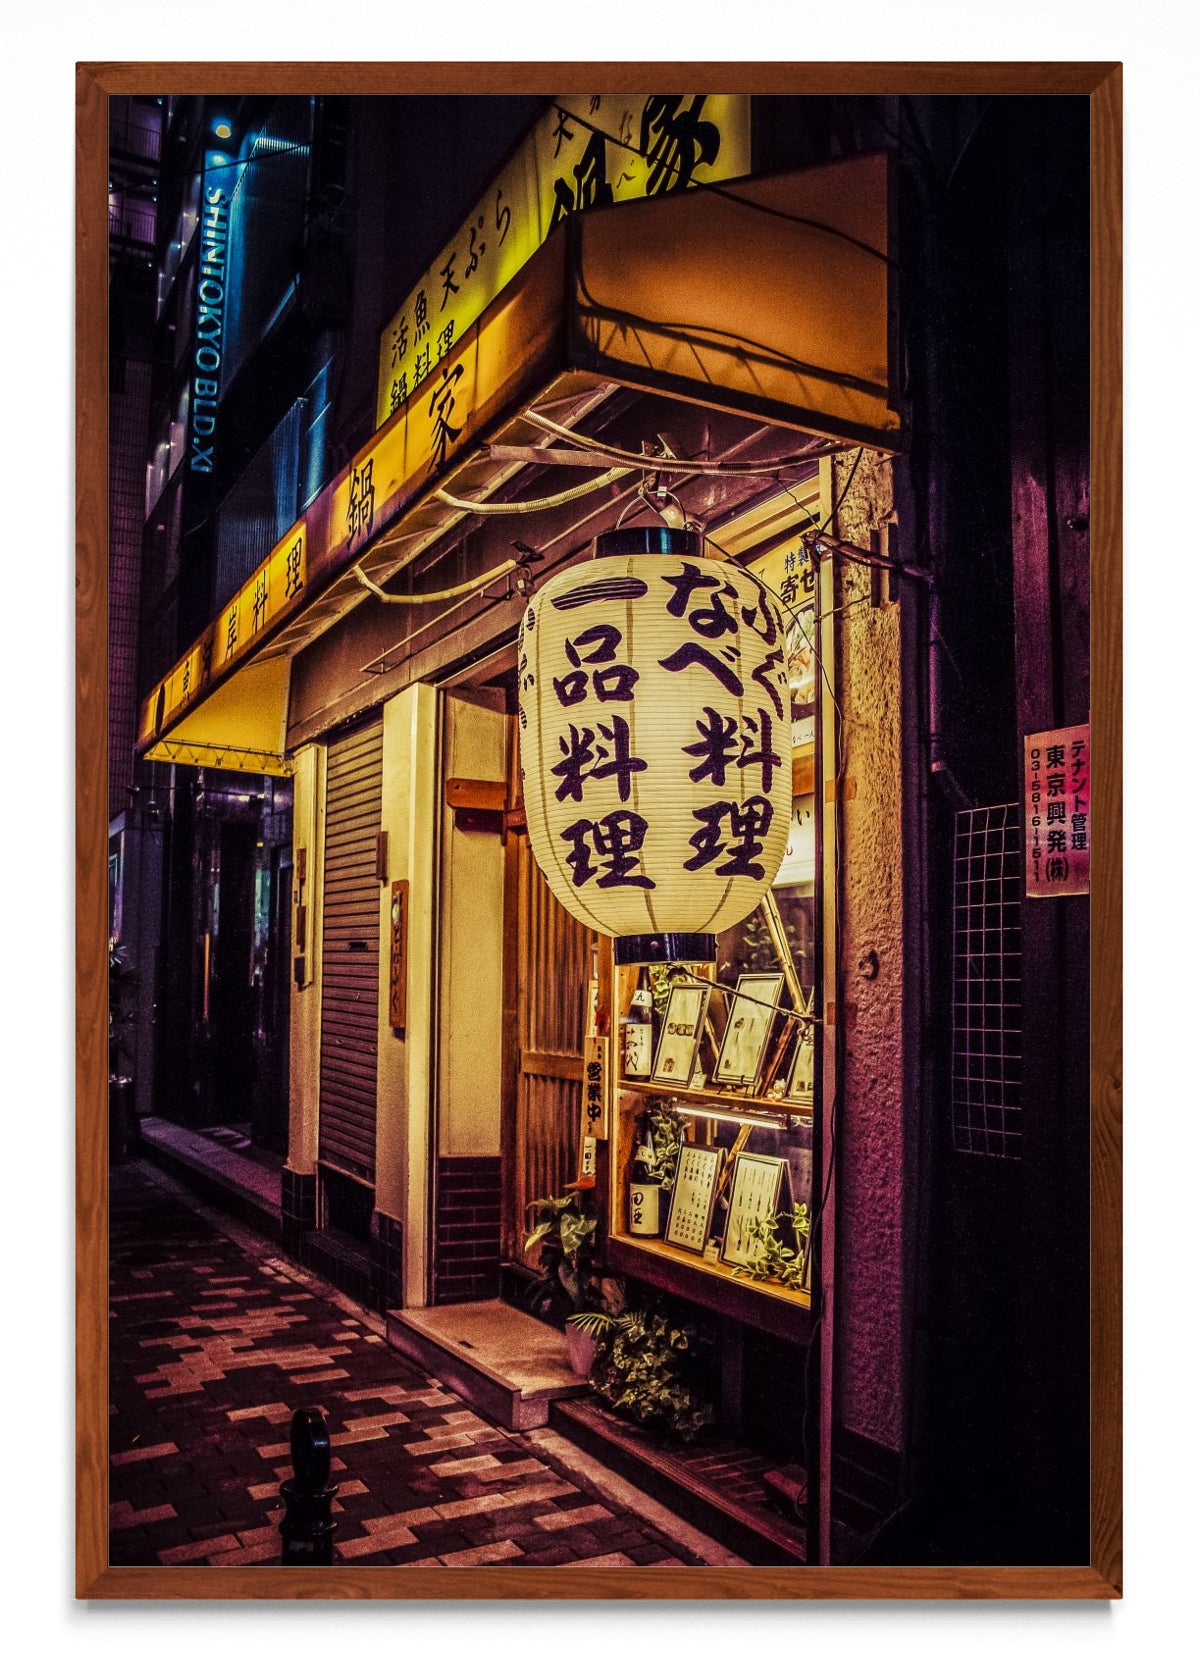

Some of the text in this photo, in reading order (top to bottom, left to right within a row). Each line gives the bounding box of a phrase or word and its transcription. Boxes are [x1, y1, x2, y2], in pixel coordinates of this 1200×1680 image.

[197, 185, 228, 372] SHINTOKYO
[346, 364, 464, 548] 鍋家
[550, 576, 656, 890] 一品料理
[657, 561, 783, 882] なべ料理
[1046, 744, 1069, 882] 東京興発(株)
[1071, 741, 1087, 851] テナント管理
[1031, 748, 1041, 883] 03-5816-1511
